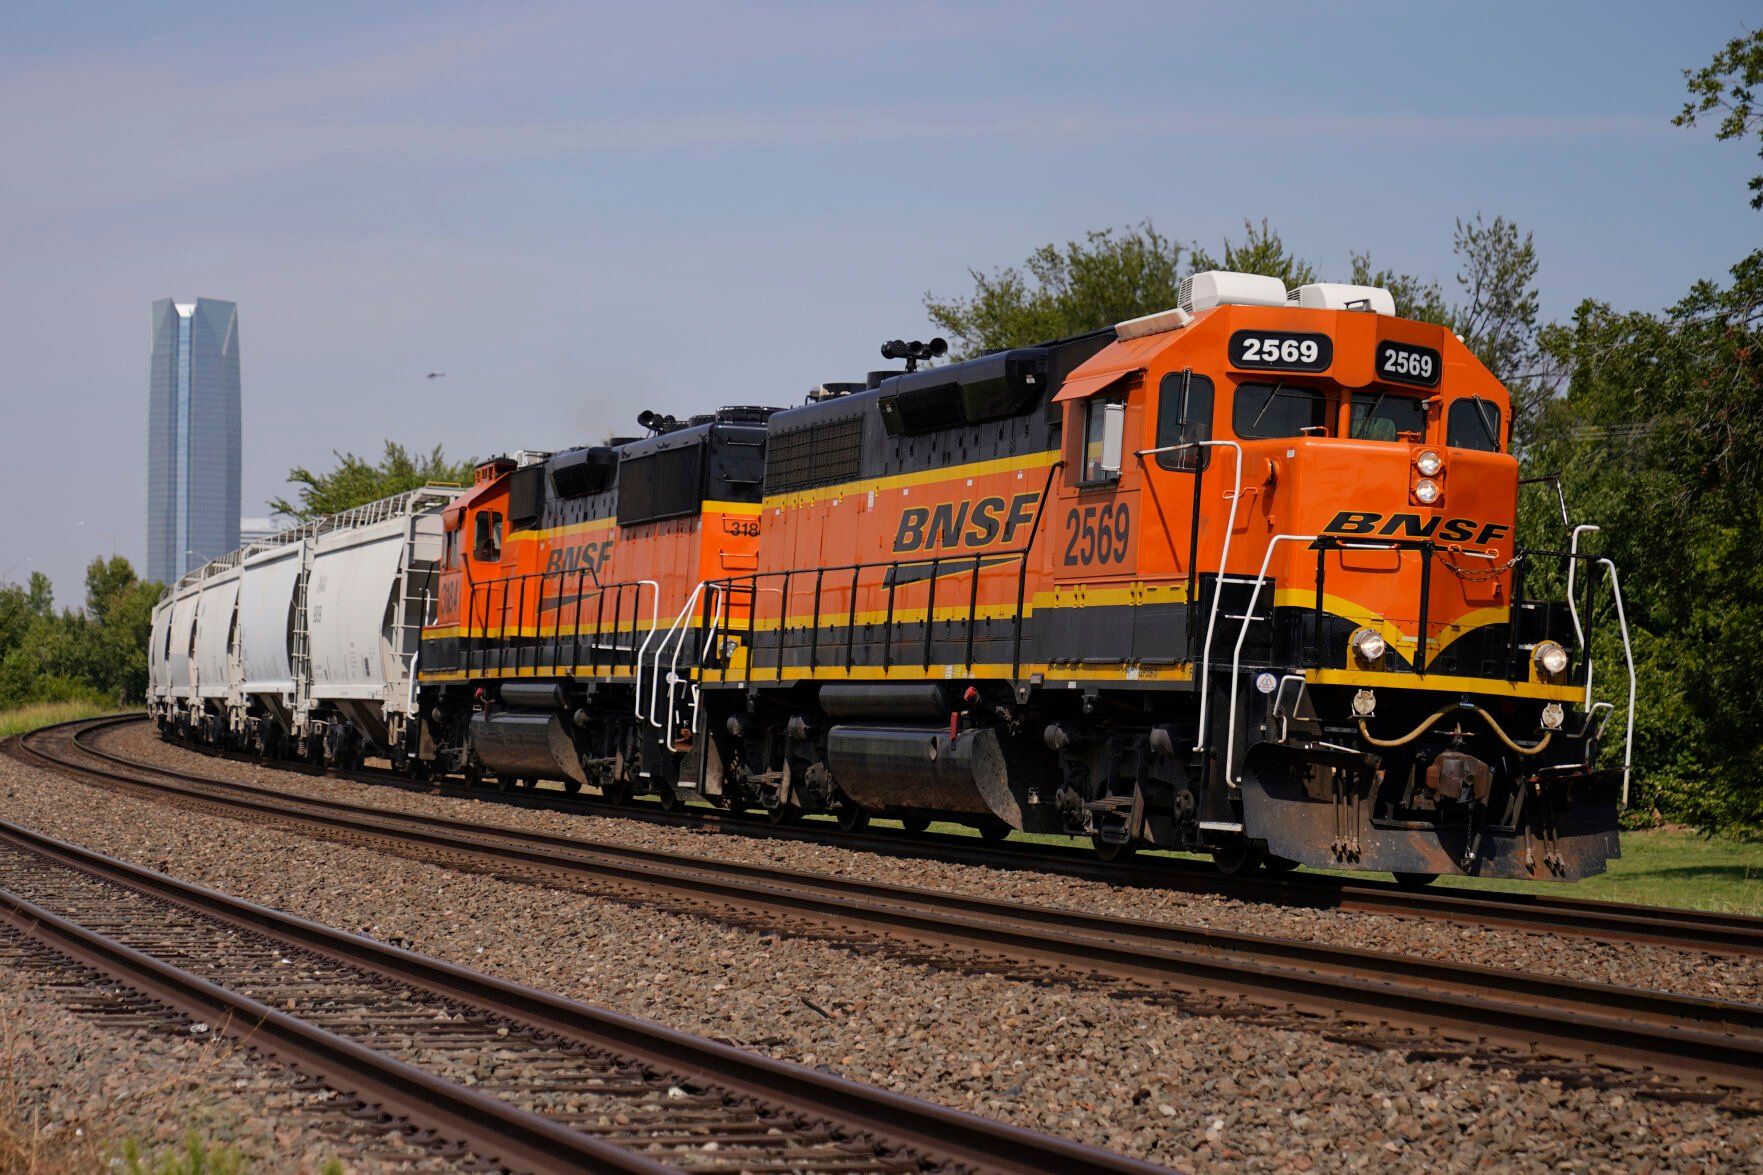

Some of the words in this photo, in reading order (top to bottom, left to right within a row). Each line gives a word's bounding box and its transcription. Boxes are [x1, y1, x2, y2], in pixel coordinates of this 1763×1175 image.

[1242, 338, 1319, 363] 2569
[1384, 349, 1432, 378] 2569
[731, 521, 760, 537] 318
[892, 492, 1041, 553] BNSF
[1063, 502, 1130, 567] 2569
[1322, 510, 1510, 545] BNSF
[544, 541, 614, 580] BNSF
